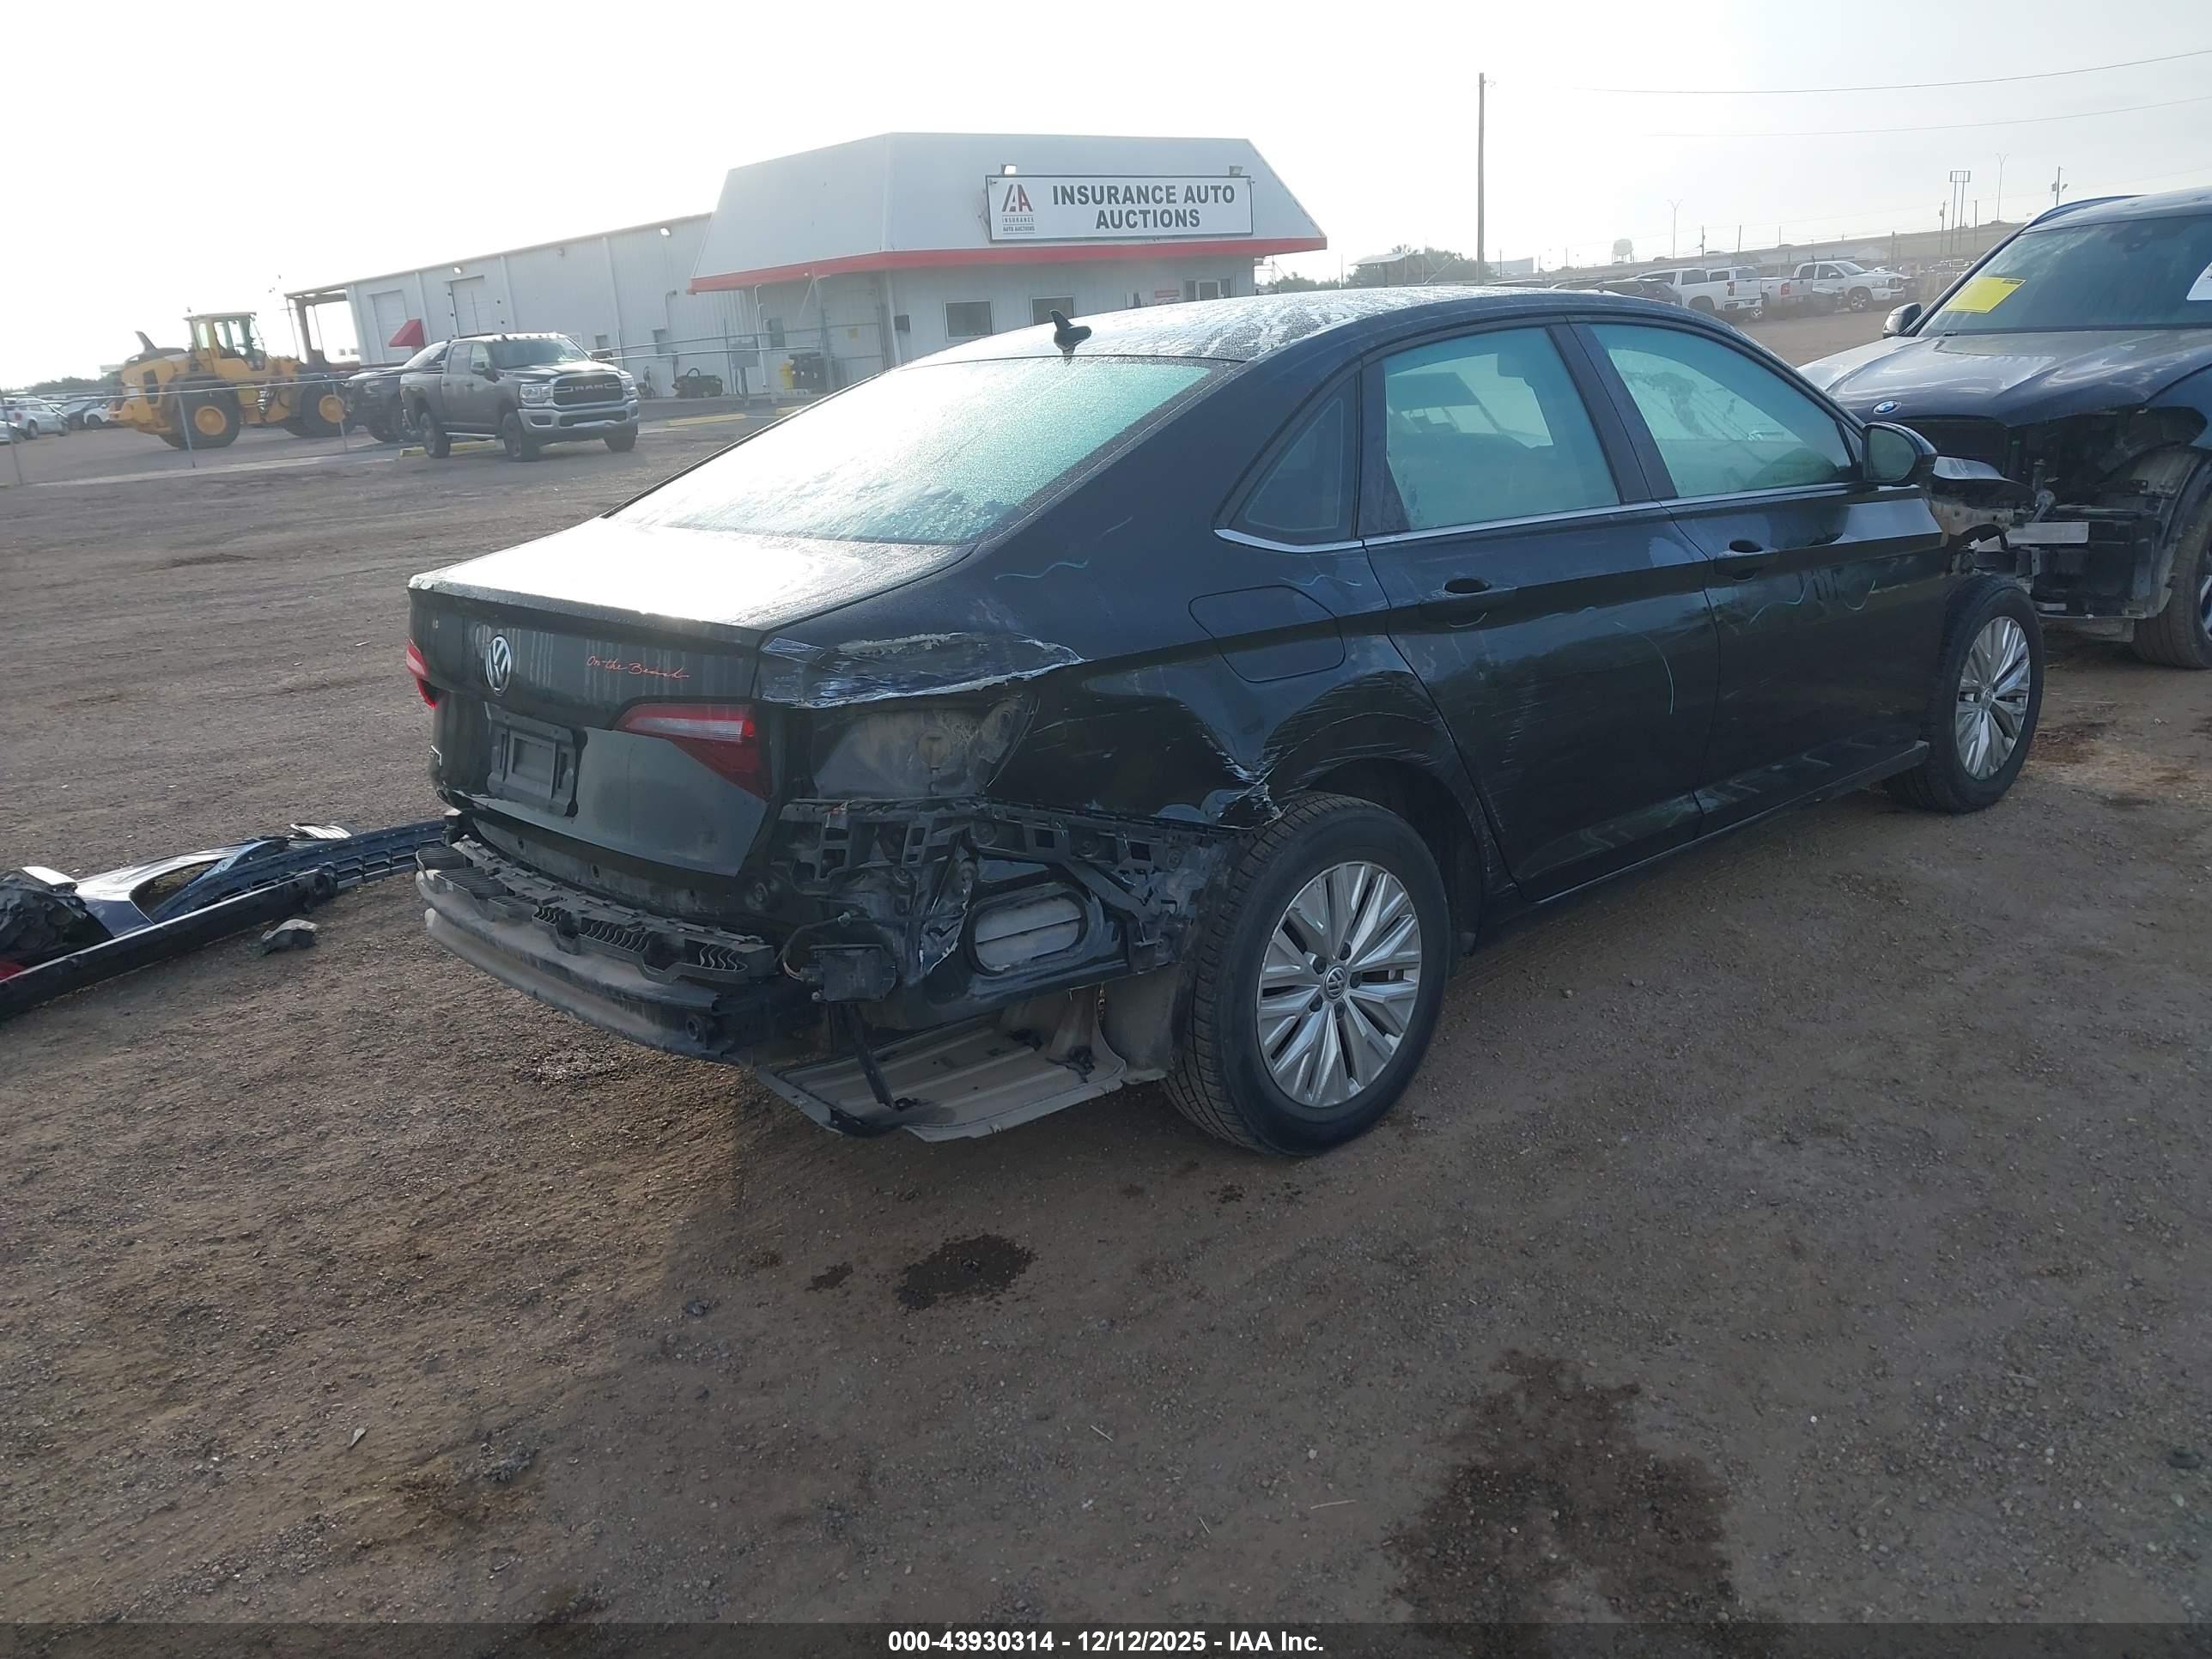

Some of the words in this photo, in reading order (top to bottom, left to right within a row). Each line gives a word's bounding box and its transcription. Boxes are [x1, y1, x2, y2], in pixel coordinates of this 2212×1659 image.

[1053, 185, 1177, 205] INSURANCE
[1183, 185, 1236, 204] AUTO
[1095, 209, 1200, 229] AUCTIONS
